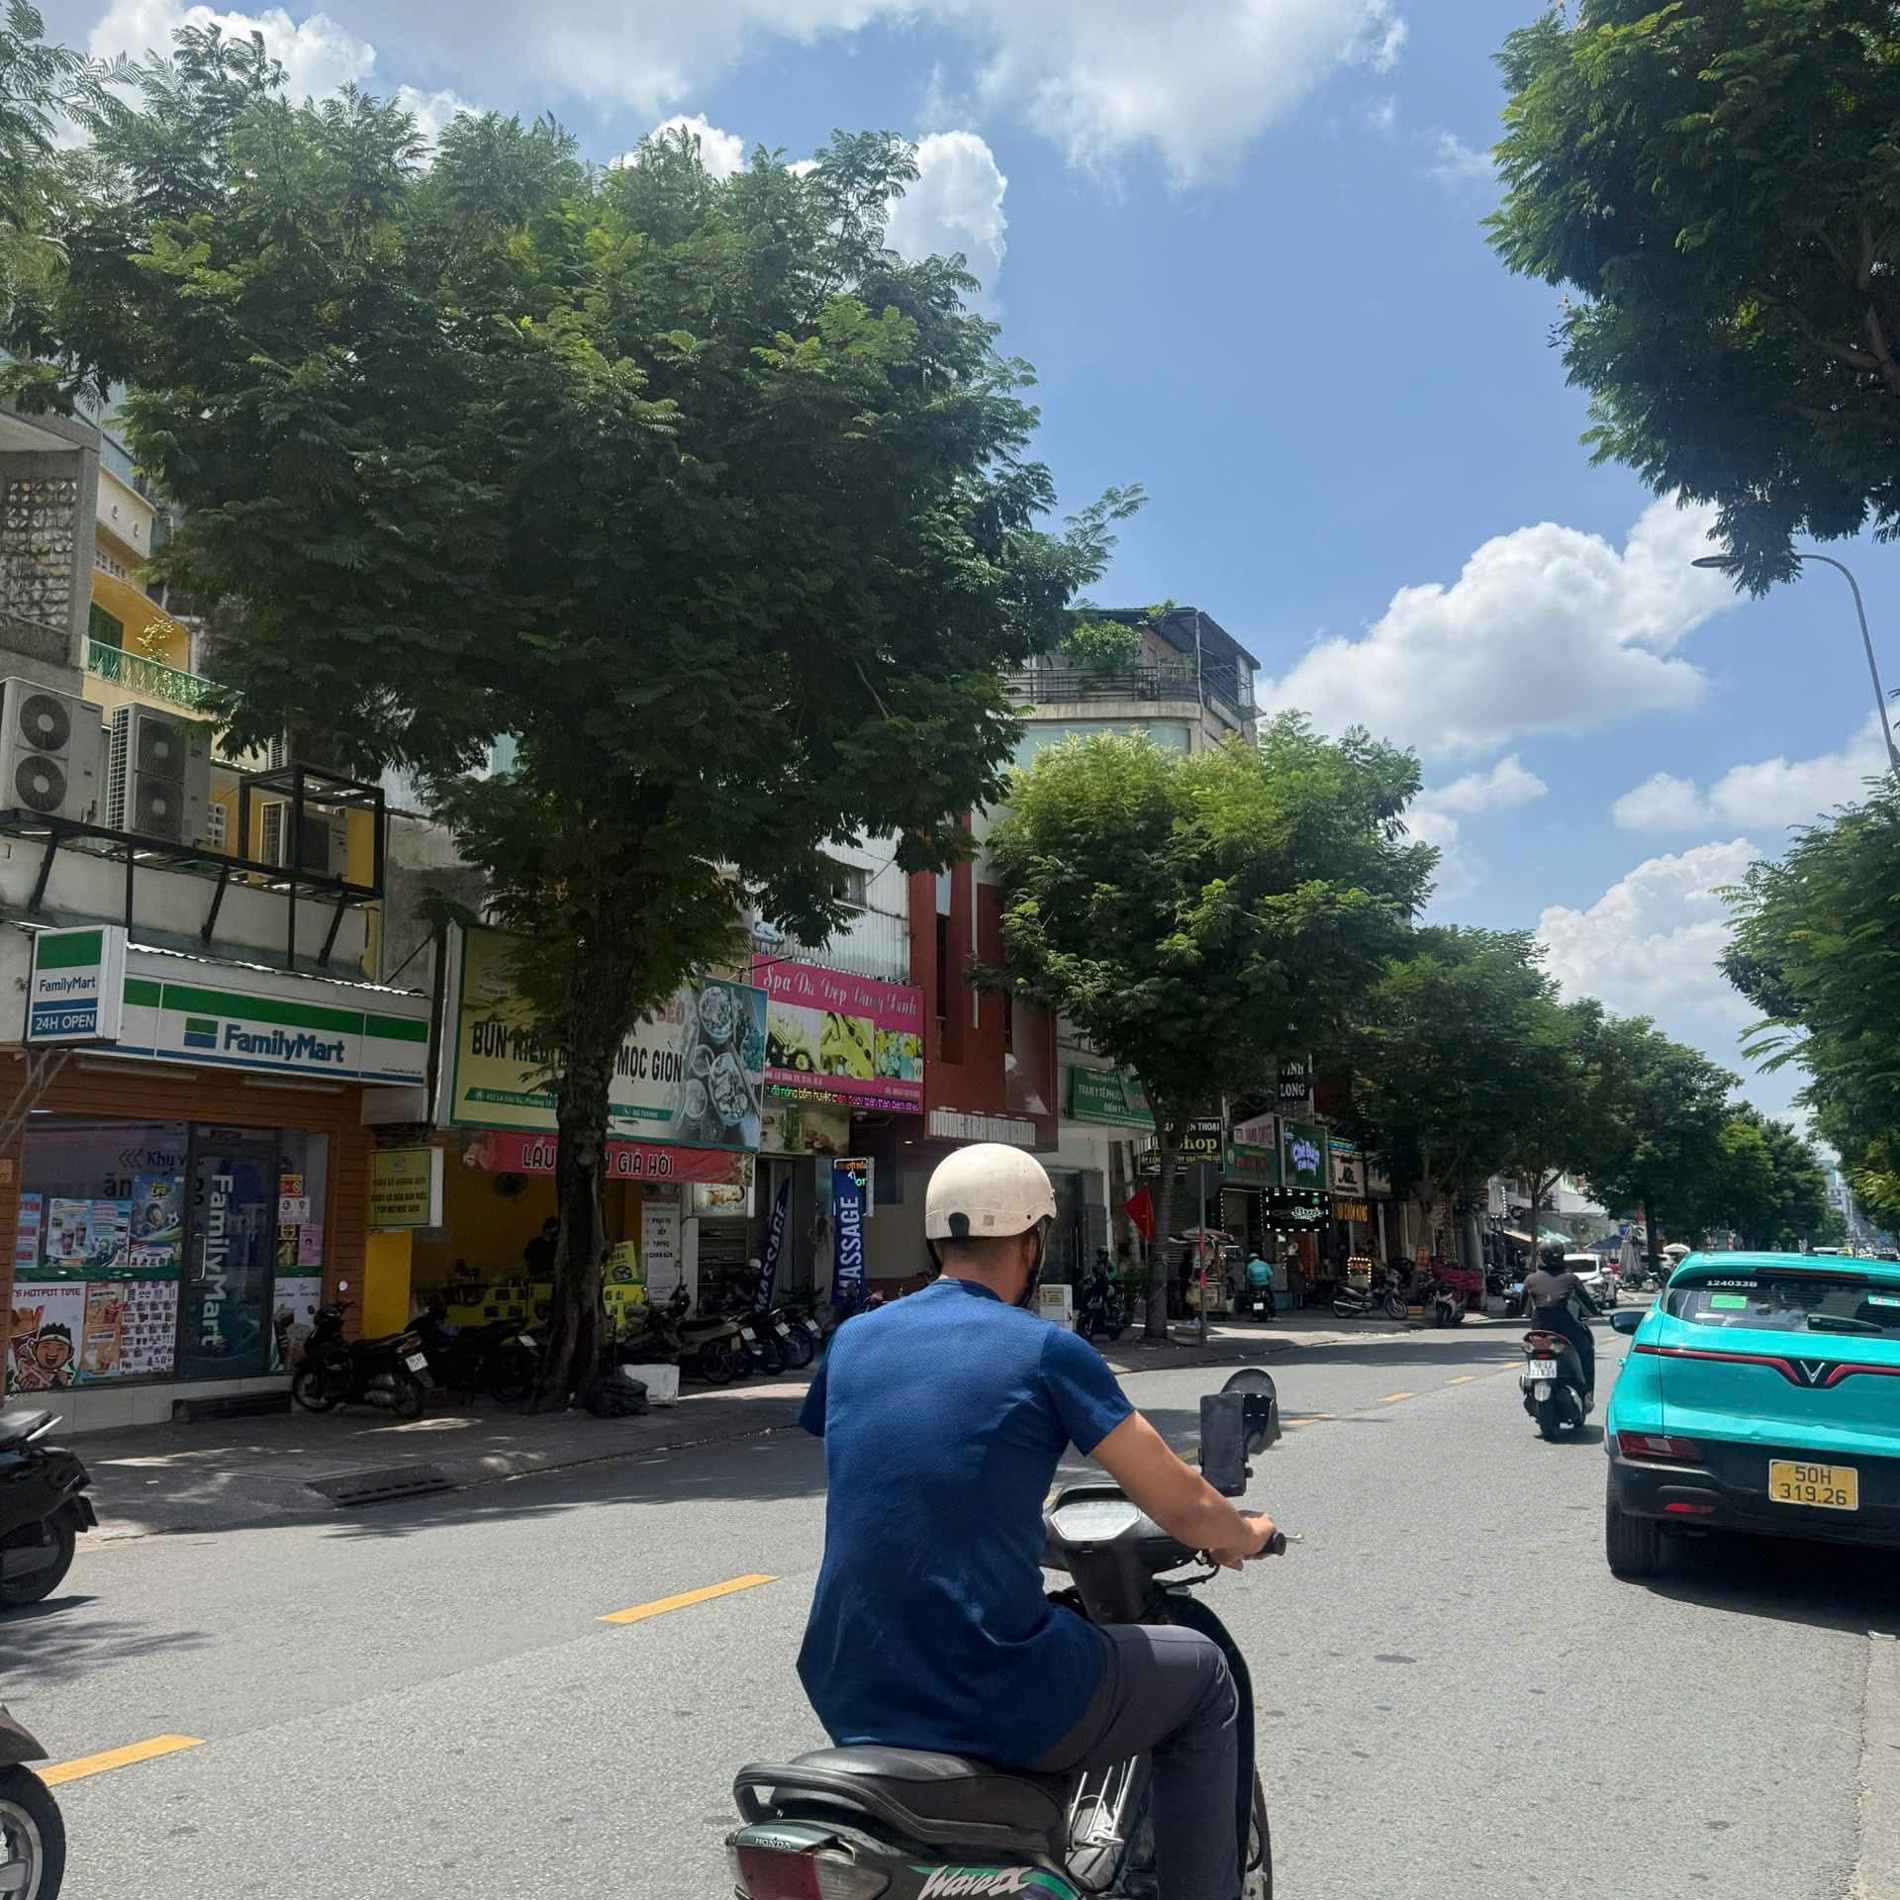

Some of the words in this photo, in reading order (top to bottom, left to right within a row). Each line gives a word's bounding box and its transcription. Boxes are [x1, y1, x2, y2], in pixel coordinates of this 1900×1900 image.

[39, 976, 96, 993] FamilyMart
[763, 965, 791, 993] Spa
[35, 1016, 58, 1030] 24H
[62, 1014, 95, 1029] OPEN
[223, 1023, 345, 1063] FamilyMart
[617, 1045, 648, 1084] MỌC
[652, 1040, 683, 1083] GIÒN
[1280, 1082, 1305, 1098] LONG
[201, 1174, 234, 1347] FamilyMart
[1795, 1466, 1831, 1485] 50H
[1779, 1483, 1847, 1505] 319.26
[754, 1837, 792, 1849] HONDA
